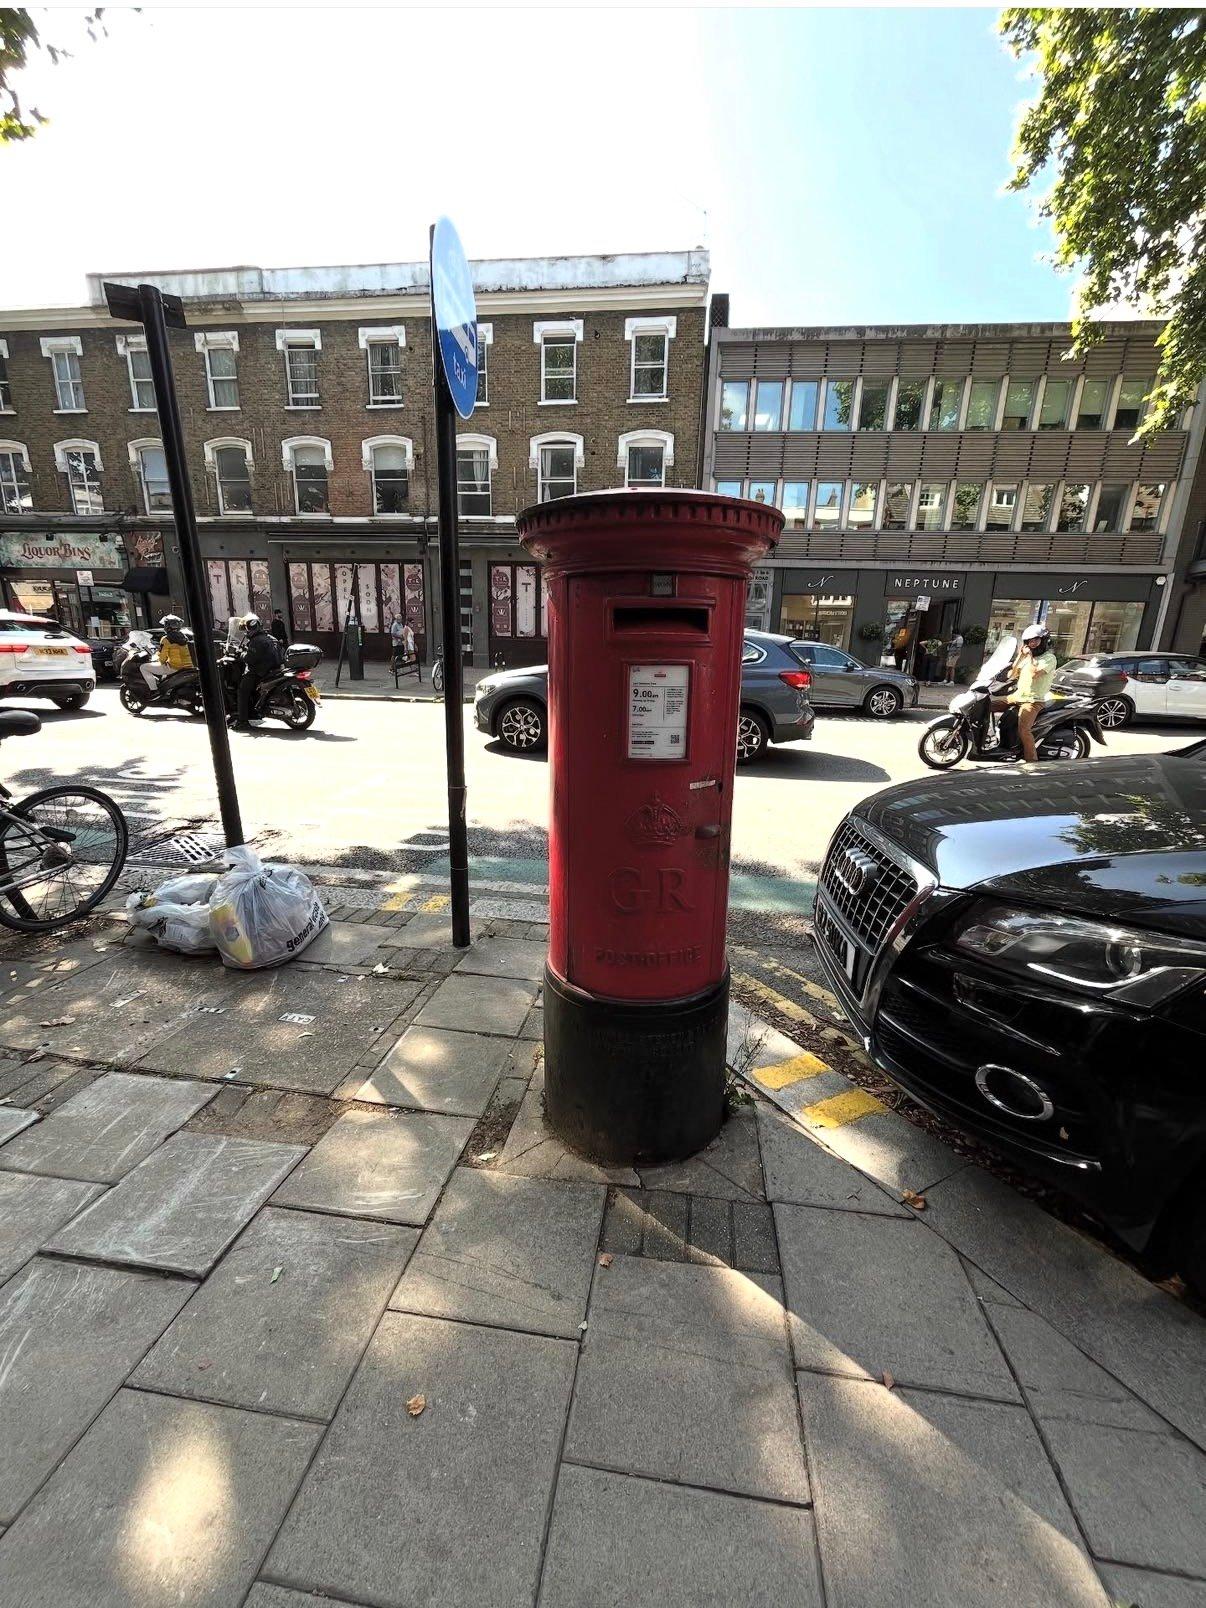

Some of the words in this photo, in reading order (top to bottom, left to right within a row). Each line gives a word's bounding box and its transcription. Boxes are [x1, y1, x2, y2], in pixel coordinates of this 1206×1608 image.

[452, 351, 467, 390] taxi
[21, 543, 62, 559] LIQUOR
[63, 543, 91, 561] BINS
[894, 578, 959, 589] NEPTUNE
[286, 917, 315, 952] general
